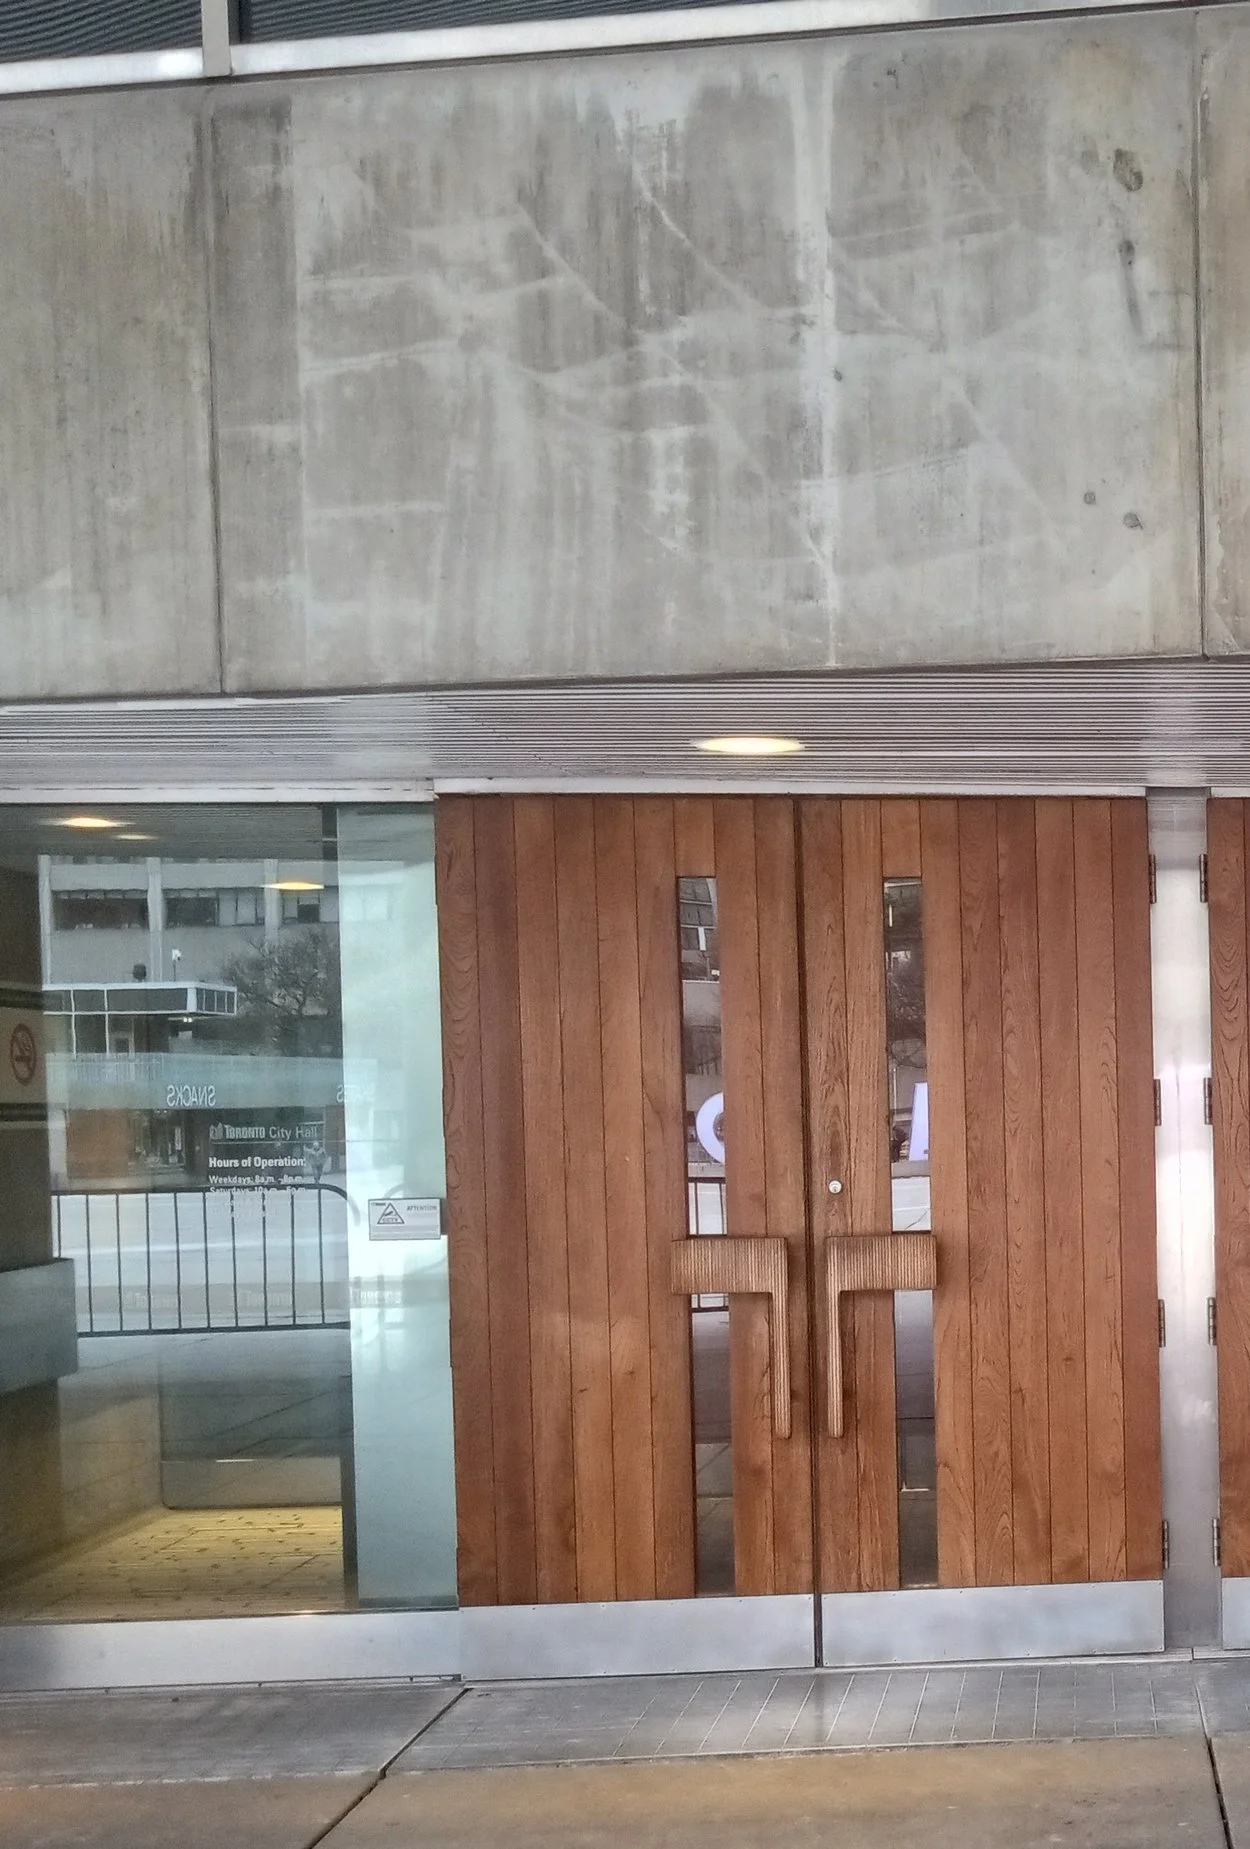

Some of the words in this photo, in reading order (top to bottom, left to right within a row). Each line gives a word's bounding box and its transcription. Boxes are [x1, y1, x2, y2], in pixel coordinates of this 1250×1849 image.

[268, 1126, 292, 1141] City
[295, 1125, 318, 1139] Hall
[208, 1156, 240, 1168] Hours
[241, 1156, 253, 1168] of
